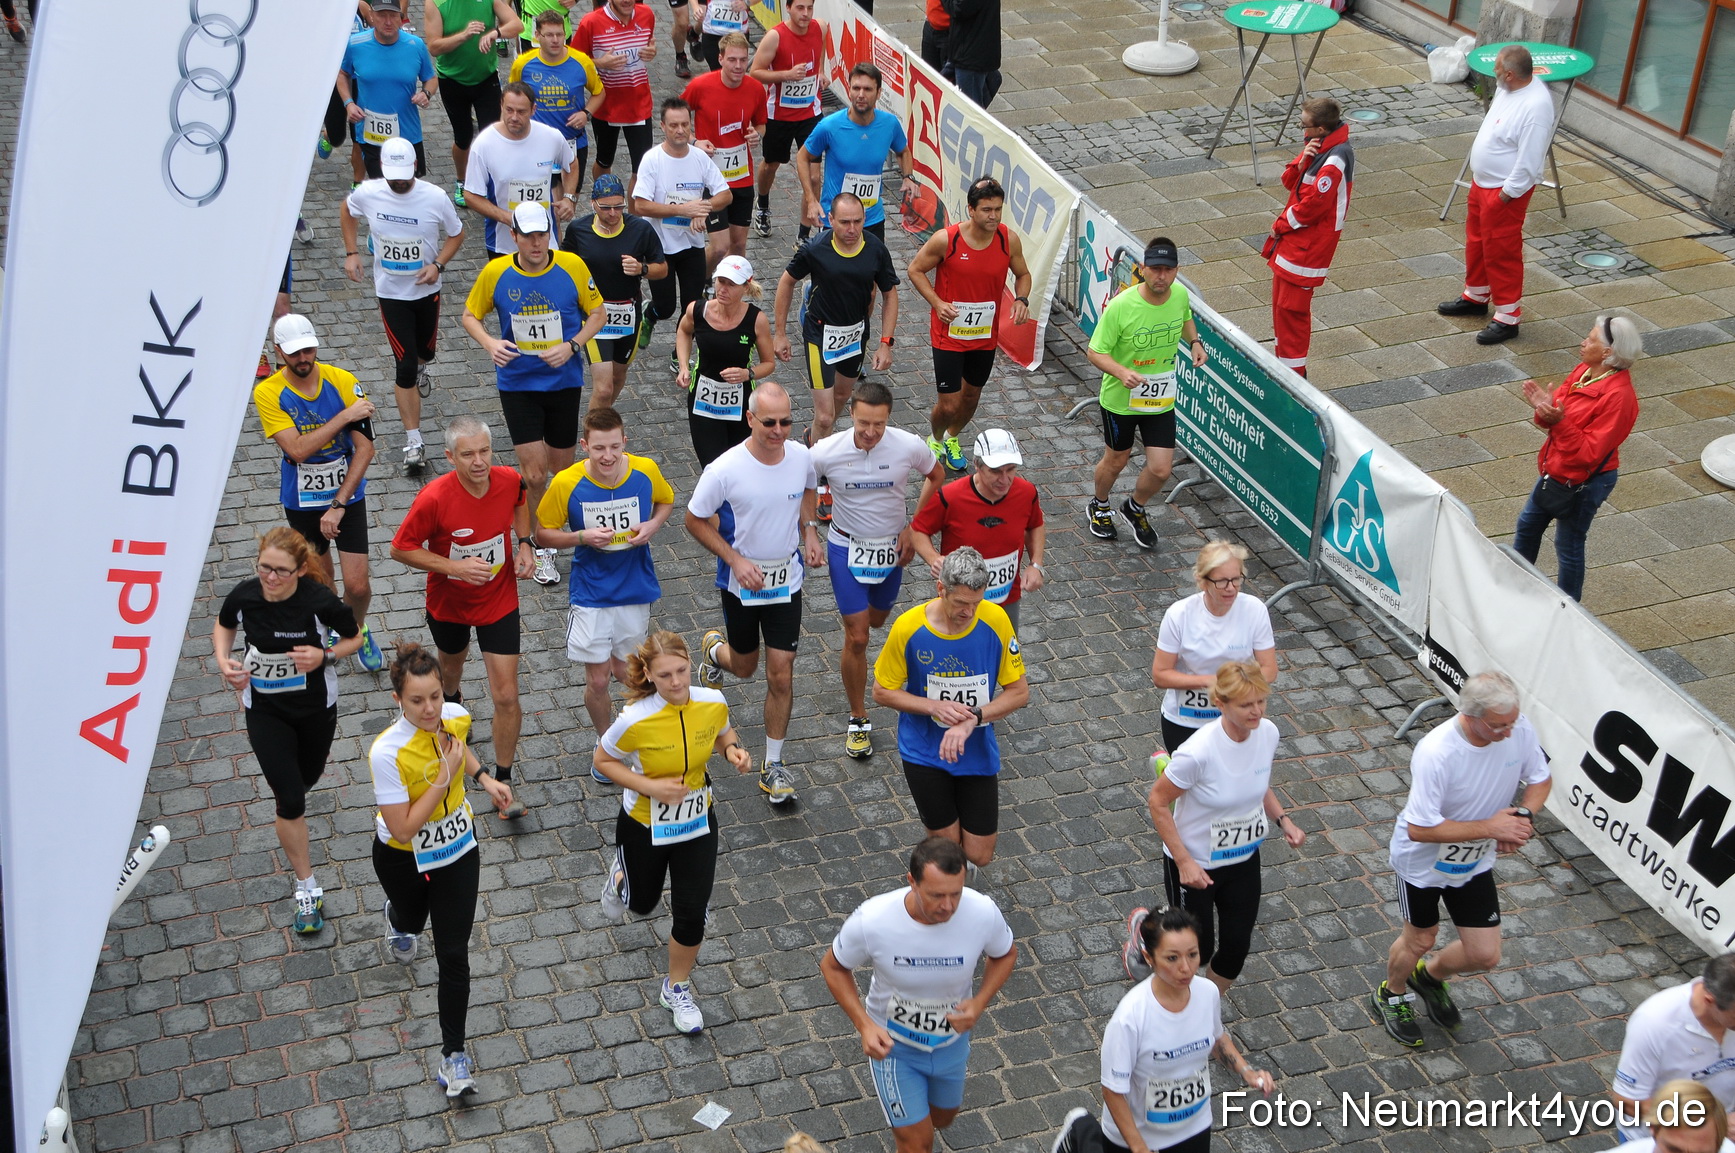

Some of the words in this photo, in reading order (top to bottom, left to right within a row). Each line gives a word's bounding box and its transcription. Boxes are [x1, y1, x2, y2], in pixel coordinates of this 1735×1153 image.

[715, 8, 740, 21] 2773
[785, 83, 814, 97] 2227
[370, 120, 392, 135] 168
[723, 155, 739, 169] 74
[724, 170, 740, 178] Simon
[518, 188, 543, 202] 192
[851, 183, 874, 197] 100
[383, 245, 420, 261] 2649
[394, 262, 409, 270] Jens
[606, 313, 632, 326] 429
[964, 312, 983, 326] 47
[528, 324, 547, 339] 41
[957, 327, 984, 335] Ferdinand
[828, 330, 860, 350] 2272
[700, 378, 714, 389] PARTL
[1140, 382, 1169, 398] 297
[121, 289, 203, 497] BKK
[700, 387, 739, 405] 2155
[704, 404, 731, 415] Manuela
[1175, 355, 1205, 394] Mehr
[1206, 382, 1265, 450] Sicherheit
[1190, 397, 1208, 425] Ihr
[1208, 415, 1247, 462] Event!
[304, 468, 346, 490] 2316
[1186, 430, 1193, 445] &
[1192, 434, 1218, 470] Service
[1218, 459, 1236, 486] Line:
[1236, 478, 1259, 508] 09181
[1260, 501, 1279, 526] 6352
[604, 503, 630, 511] Neumarkt
[596, 511, 630, 530] 315
[452, 545, 470, 553] PARTL
[471, 542, 497, 552] Neumarkt
[854, 547, 895, 566] 2766
[762, 568, 788, 587] 719
[861, 569, 886, 577] Konrad
[988, 563, 1015, 588] 288
[750, 589, 779, 599] Matthias
[989, 588, 1007, 599] Josef
[1354, 568, 1379, 594] Service
[1379, 588, 1401, 612] GmbH
[79, 539, 167, 764] Audi
[250, 661, 298, 678] 2751
[263, 681, 285, 689] Irene
[928, 679, 949, 688] PARTL
[940, 689, 978, 708] 645
[657, 794, 704, 822] 2778
[418, 812, 468, 850] 2435
[663, 821, 700, 836] Christiane
[1217, 819, 1265, 848] 2716
[432, 841, 465, 860] Stefanie
[1567, 784, 1721, 931] stadtwerke
[914, 1001, 949, 1011] Neumarkt
[893, 1005, 951, 1034] 2454
[908, 1030, 930, 1045] Paul
[1153, 1079, 1206, 1109] 2638
